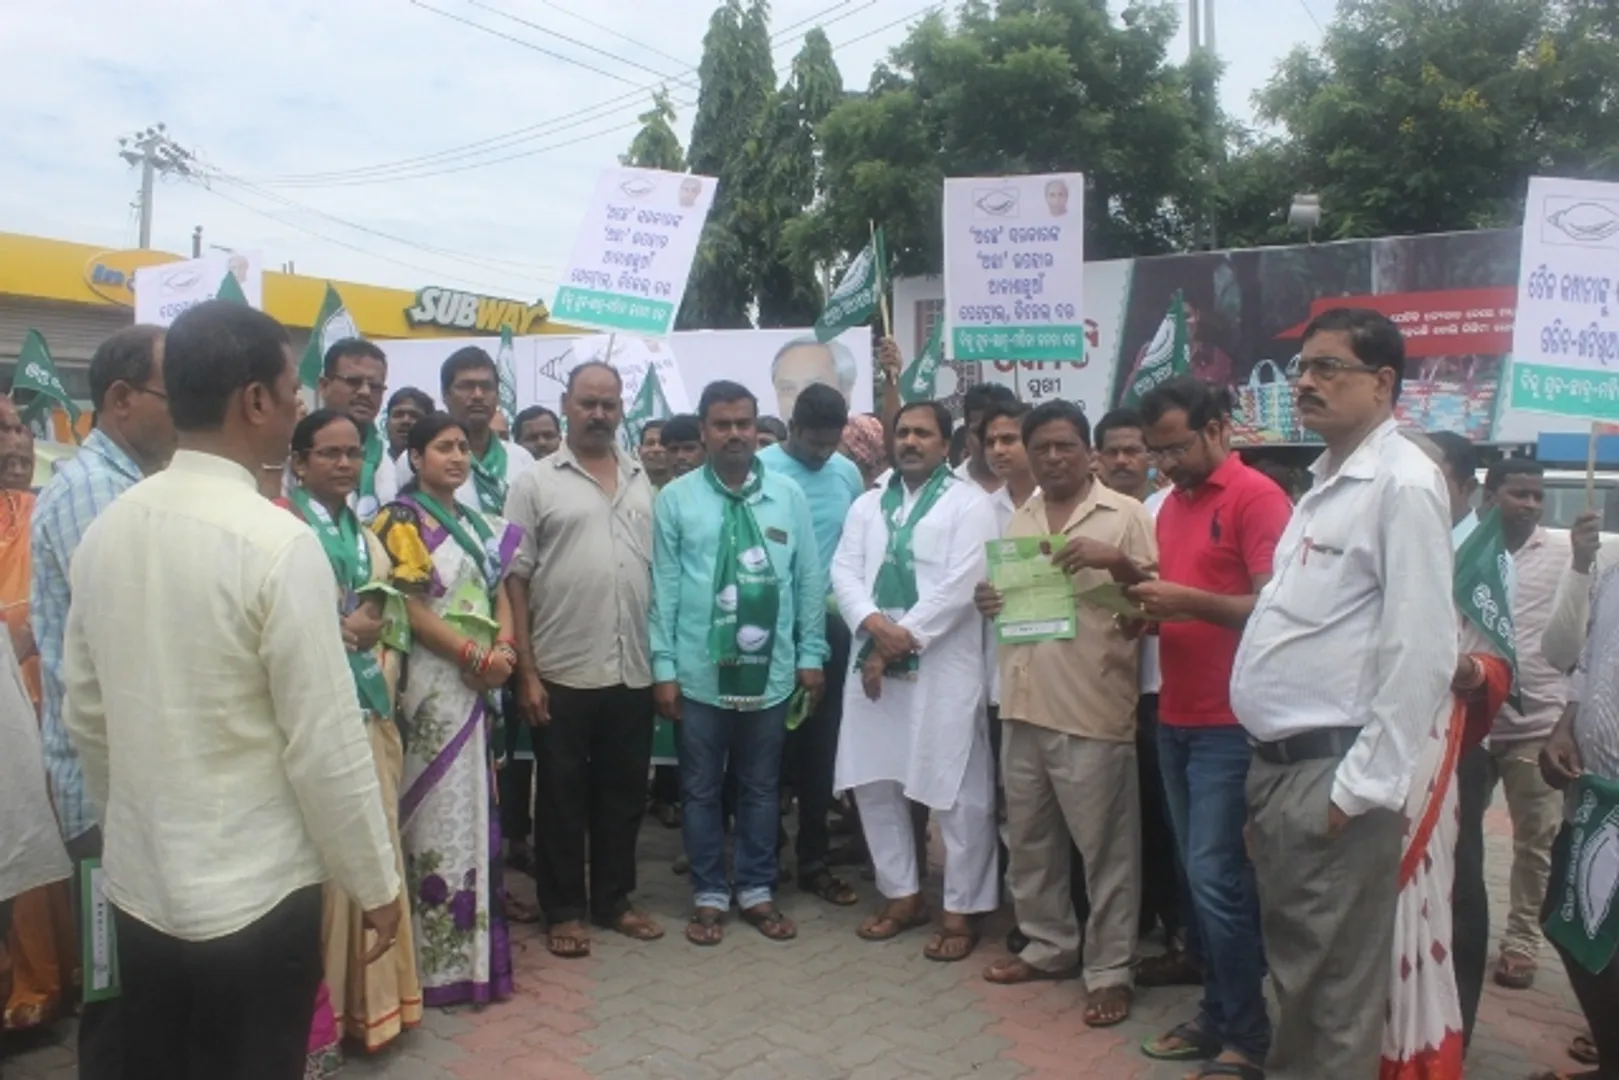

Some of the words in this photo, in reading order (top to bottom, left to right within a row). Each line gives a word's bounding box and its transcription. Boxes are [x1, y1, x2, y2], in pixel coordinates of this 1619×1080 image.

[1009, 225, 1062, 244] ସରକାରଙ୍କ
[411, 287, 549, 333] SUBWAY
[1055, 303, 1075, 320] ଦର
[1520, 367, 1540, 399] ବିଜୁ
